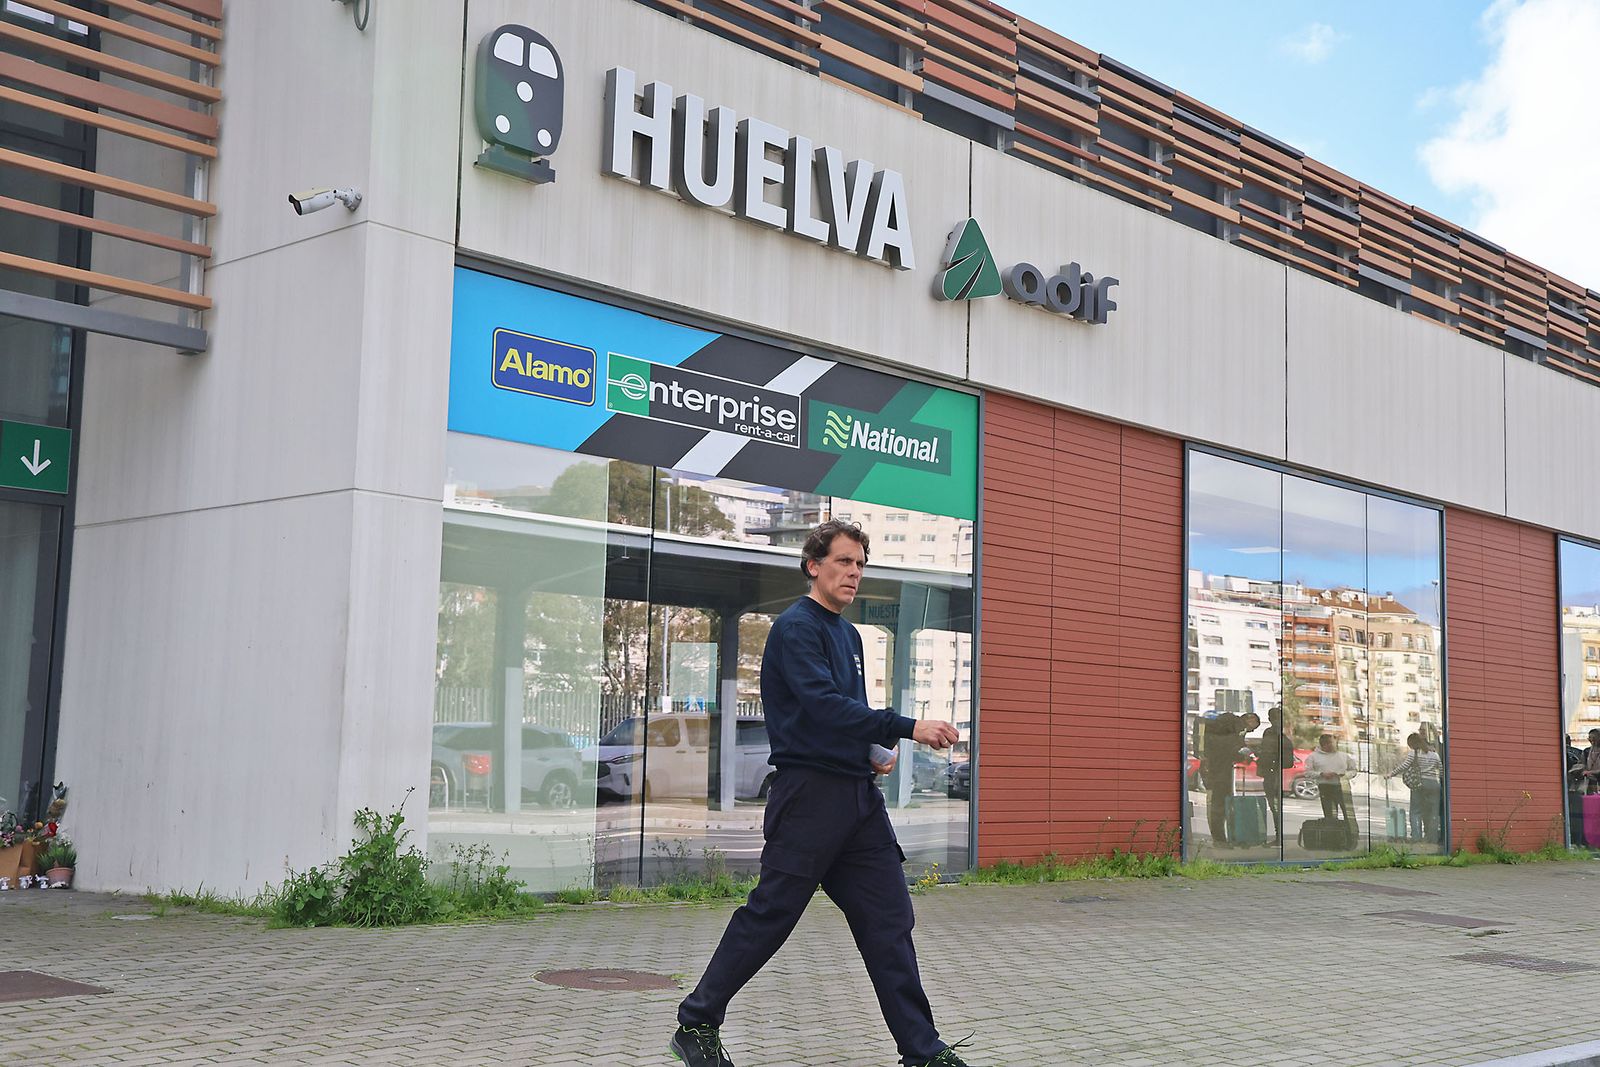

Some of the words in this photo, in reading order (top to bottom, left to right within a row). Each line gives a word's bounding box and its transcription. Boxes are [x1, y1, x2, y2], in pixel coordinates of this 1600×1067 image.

[602, 67, 914, 270] HUELVA
[1002, 261, 1119, 324] adif
[500, 348, 590, 388] Alamo
[619, 373, 797, 431] enterprise
[735, 421, 796, 443] rent-a-car
